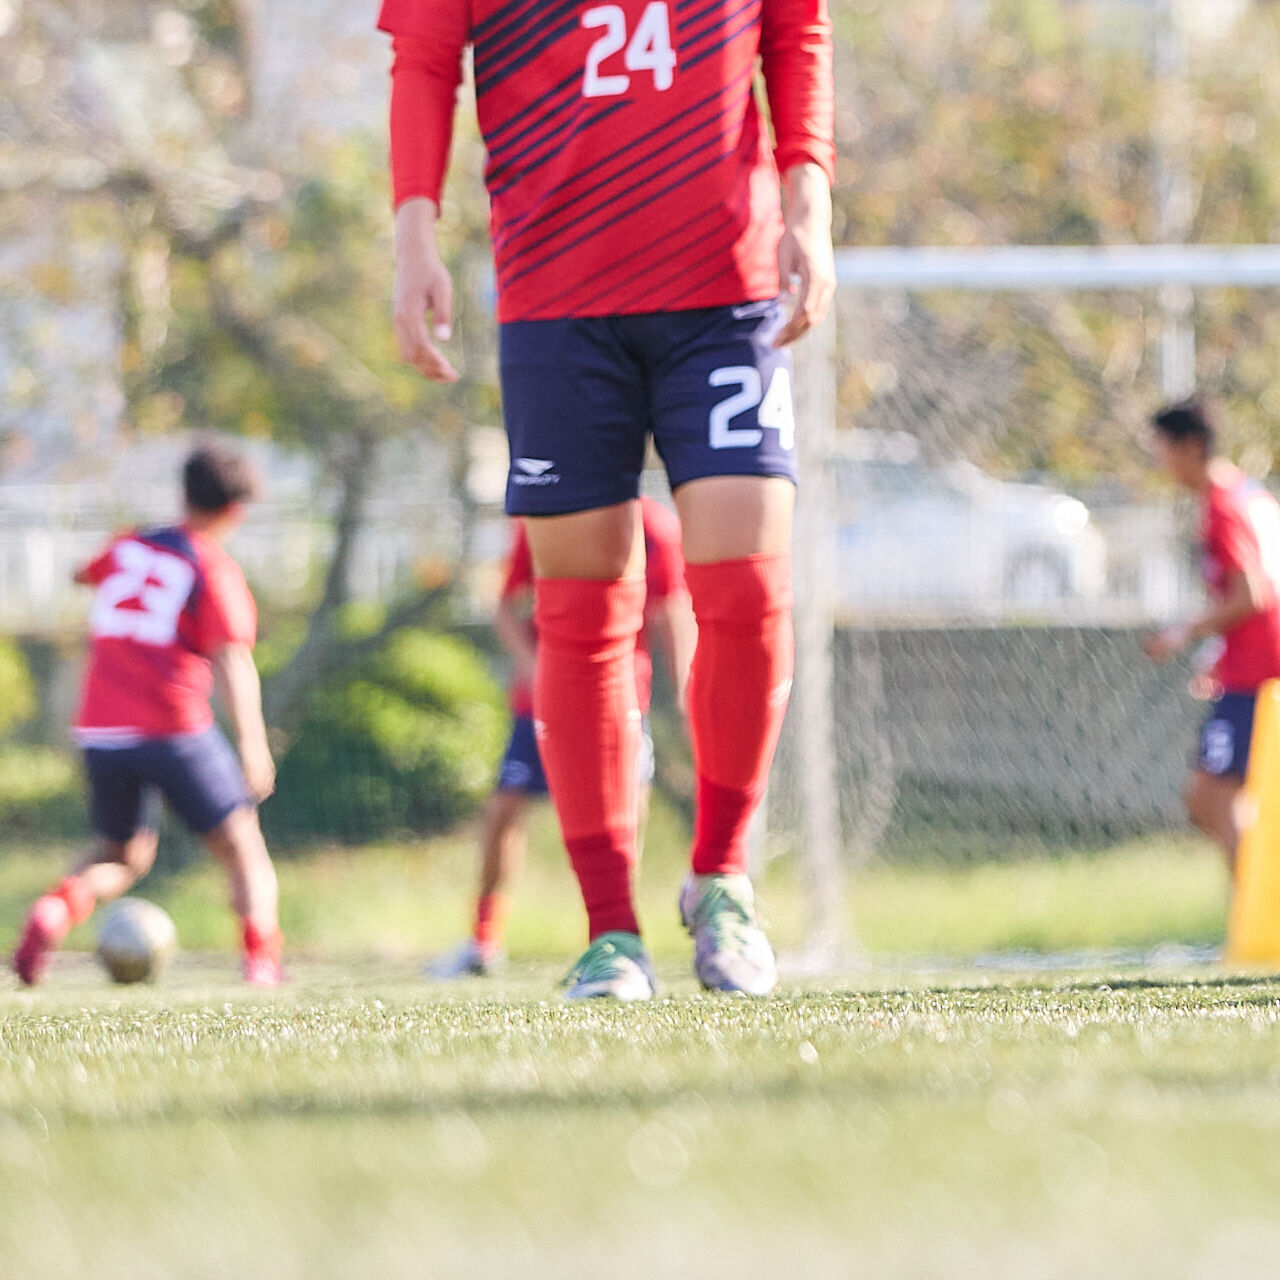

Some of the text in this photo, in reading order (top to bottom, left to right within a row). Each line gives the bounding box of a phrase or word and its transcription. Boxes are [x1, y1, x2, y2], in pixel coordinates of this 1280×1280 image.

[580, 1, 677, 98] 24
[708, 365, 795, 451] 24
[94, 539, 197, 648] 23
